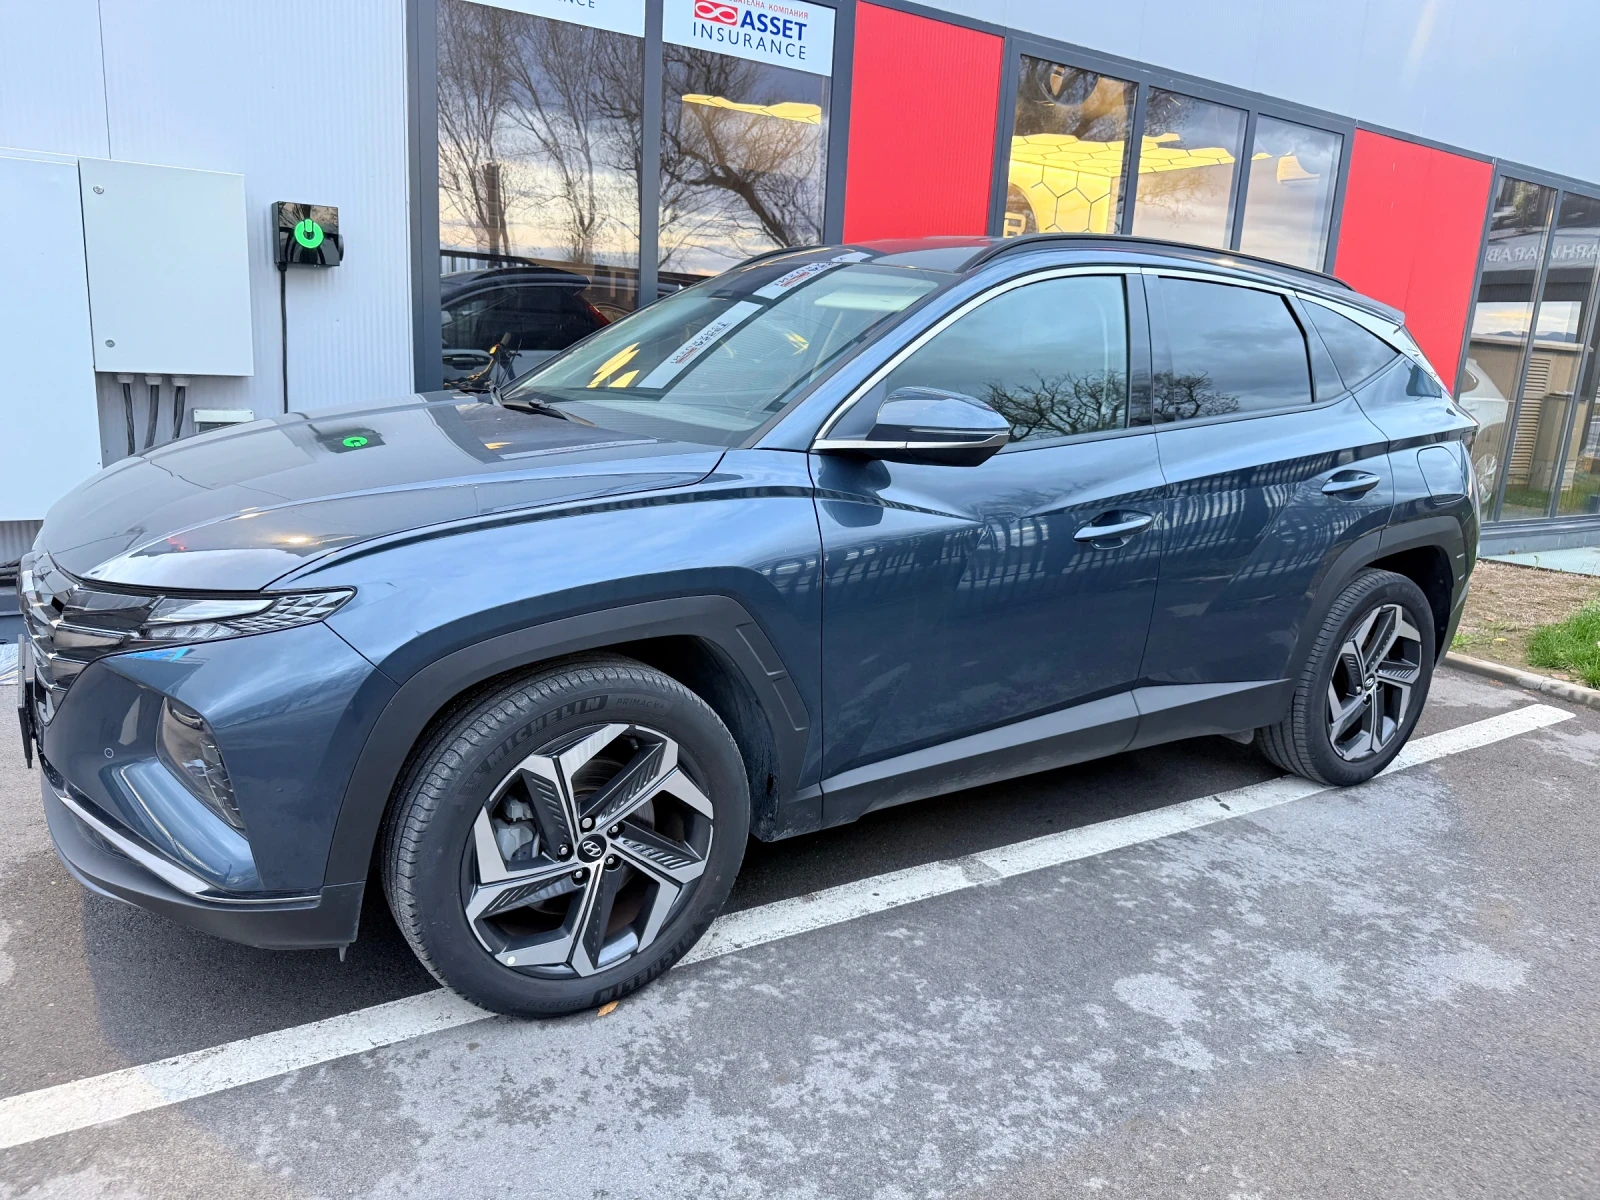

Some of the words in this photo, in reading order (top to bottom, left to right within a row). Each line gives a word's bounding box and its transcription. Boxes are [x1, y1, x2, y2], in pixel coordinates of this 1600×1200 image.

[740, 10, 807, 41] ASSET
[768, 4, 809, 19] КОМПАНИЯ
[693, 21, 807, 60] INSURANCE
[486, 695, 601, 768] MICHELIN
[599, 922, 702, 1002] MICHELIN
